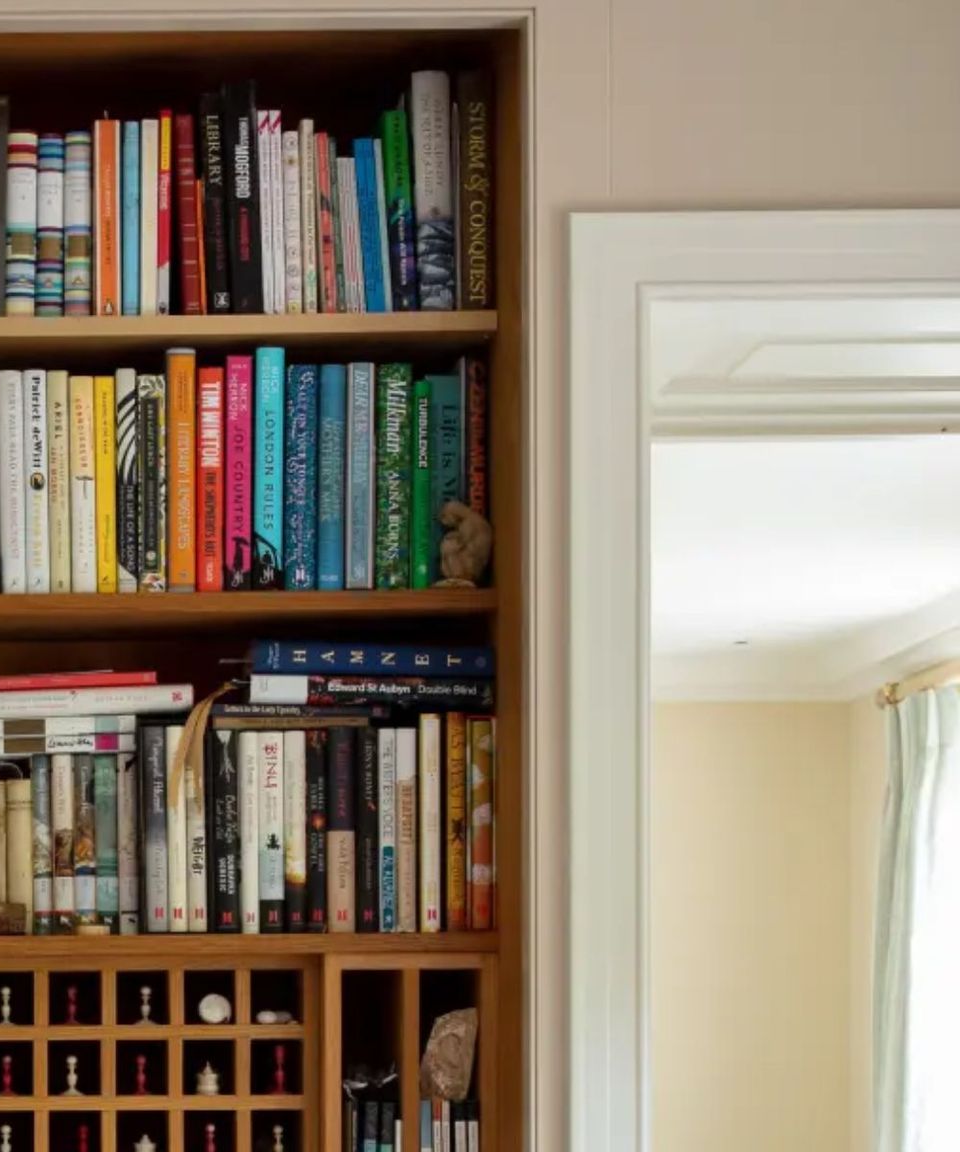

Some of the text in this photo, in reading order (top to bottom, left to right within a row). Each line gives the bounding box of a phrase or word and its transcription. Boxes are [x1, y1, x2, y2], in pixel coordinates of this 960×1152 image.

[206, 115, 222, 186] LIBRARY
[468, 102, 486, 168] STORM
[235, 144, 250, 198] MOGFORD
[469, 199, 487, 305] CONQUEST
[32, 376, 42, 422] Patrick
[53, 402, 62, 439] ARIEL
[229, 373, 239, 421] HERRON
[239, 383, 248, 411] MICK
[387, 378, 407, 453] Milkman
[201, 381, 220, 468] TIM WINTON
[419, 398, 428, 468] TURBULENCE
[442, 405, 458, 445] Life
[233, 426, 244, 532] JOE COUNTRY
[263, 410, 275, 531] LONDON RULES
[442, 453, 456, 469] is
[126, 525, 134, 535] OF
[387, 470, 400, 560] ANNA BURNS
[293, 650, 461, 667] HAMNET
[327, 682, 411, 692] Edward St Aubyn
[417, 684, 477, 695] Double Blind
